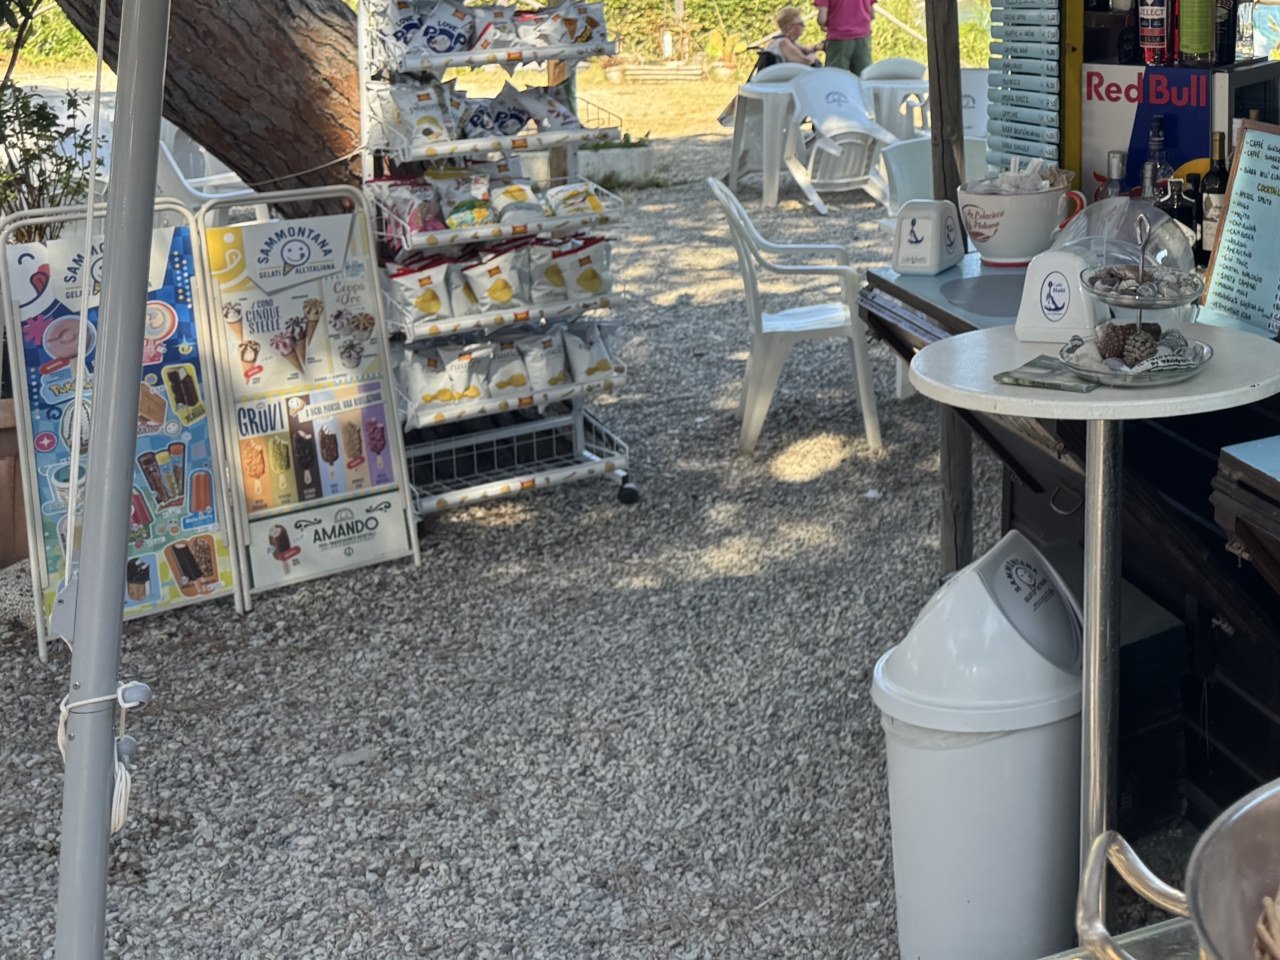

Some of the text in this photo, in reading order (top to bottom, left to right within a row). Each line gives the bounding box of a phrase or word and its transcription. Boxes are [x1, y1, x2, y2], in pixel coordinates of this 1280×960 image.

[437, 20, 459, 30] LOVE
[423, 26, 468, 53] POP
[1086, 70, 1207, 108] Red Bull
[257, 226, 333, 264] SAMMONTANA
[258, 263, 336, 280] GELATI ALL'ITALIANA
[245, 306, 281, 322] CINQUE
[248, 320, 282, 335] STELLE
[312, 516, 379, 544] AMANDO
